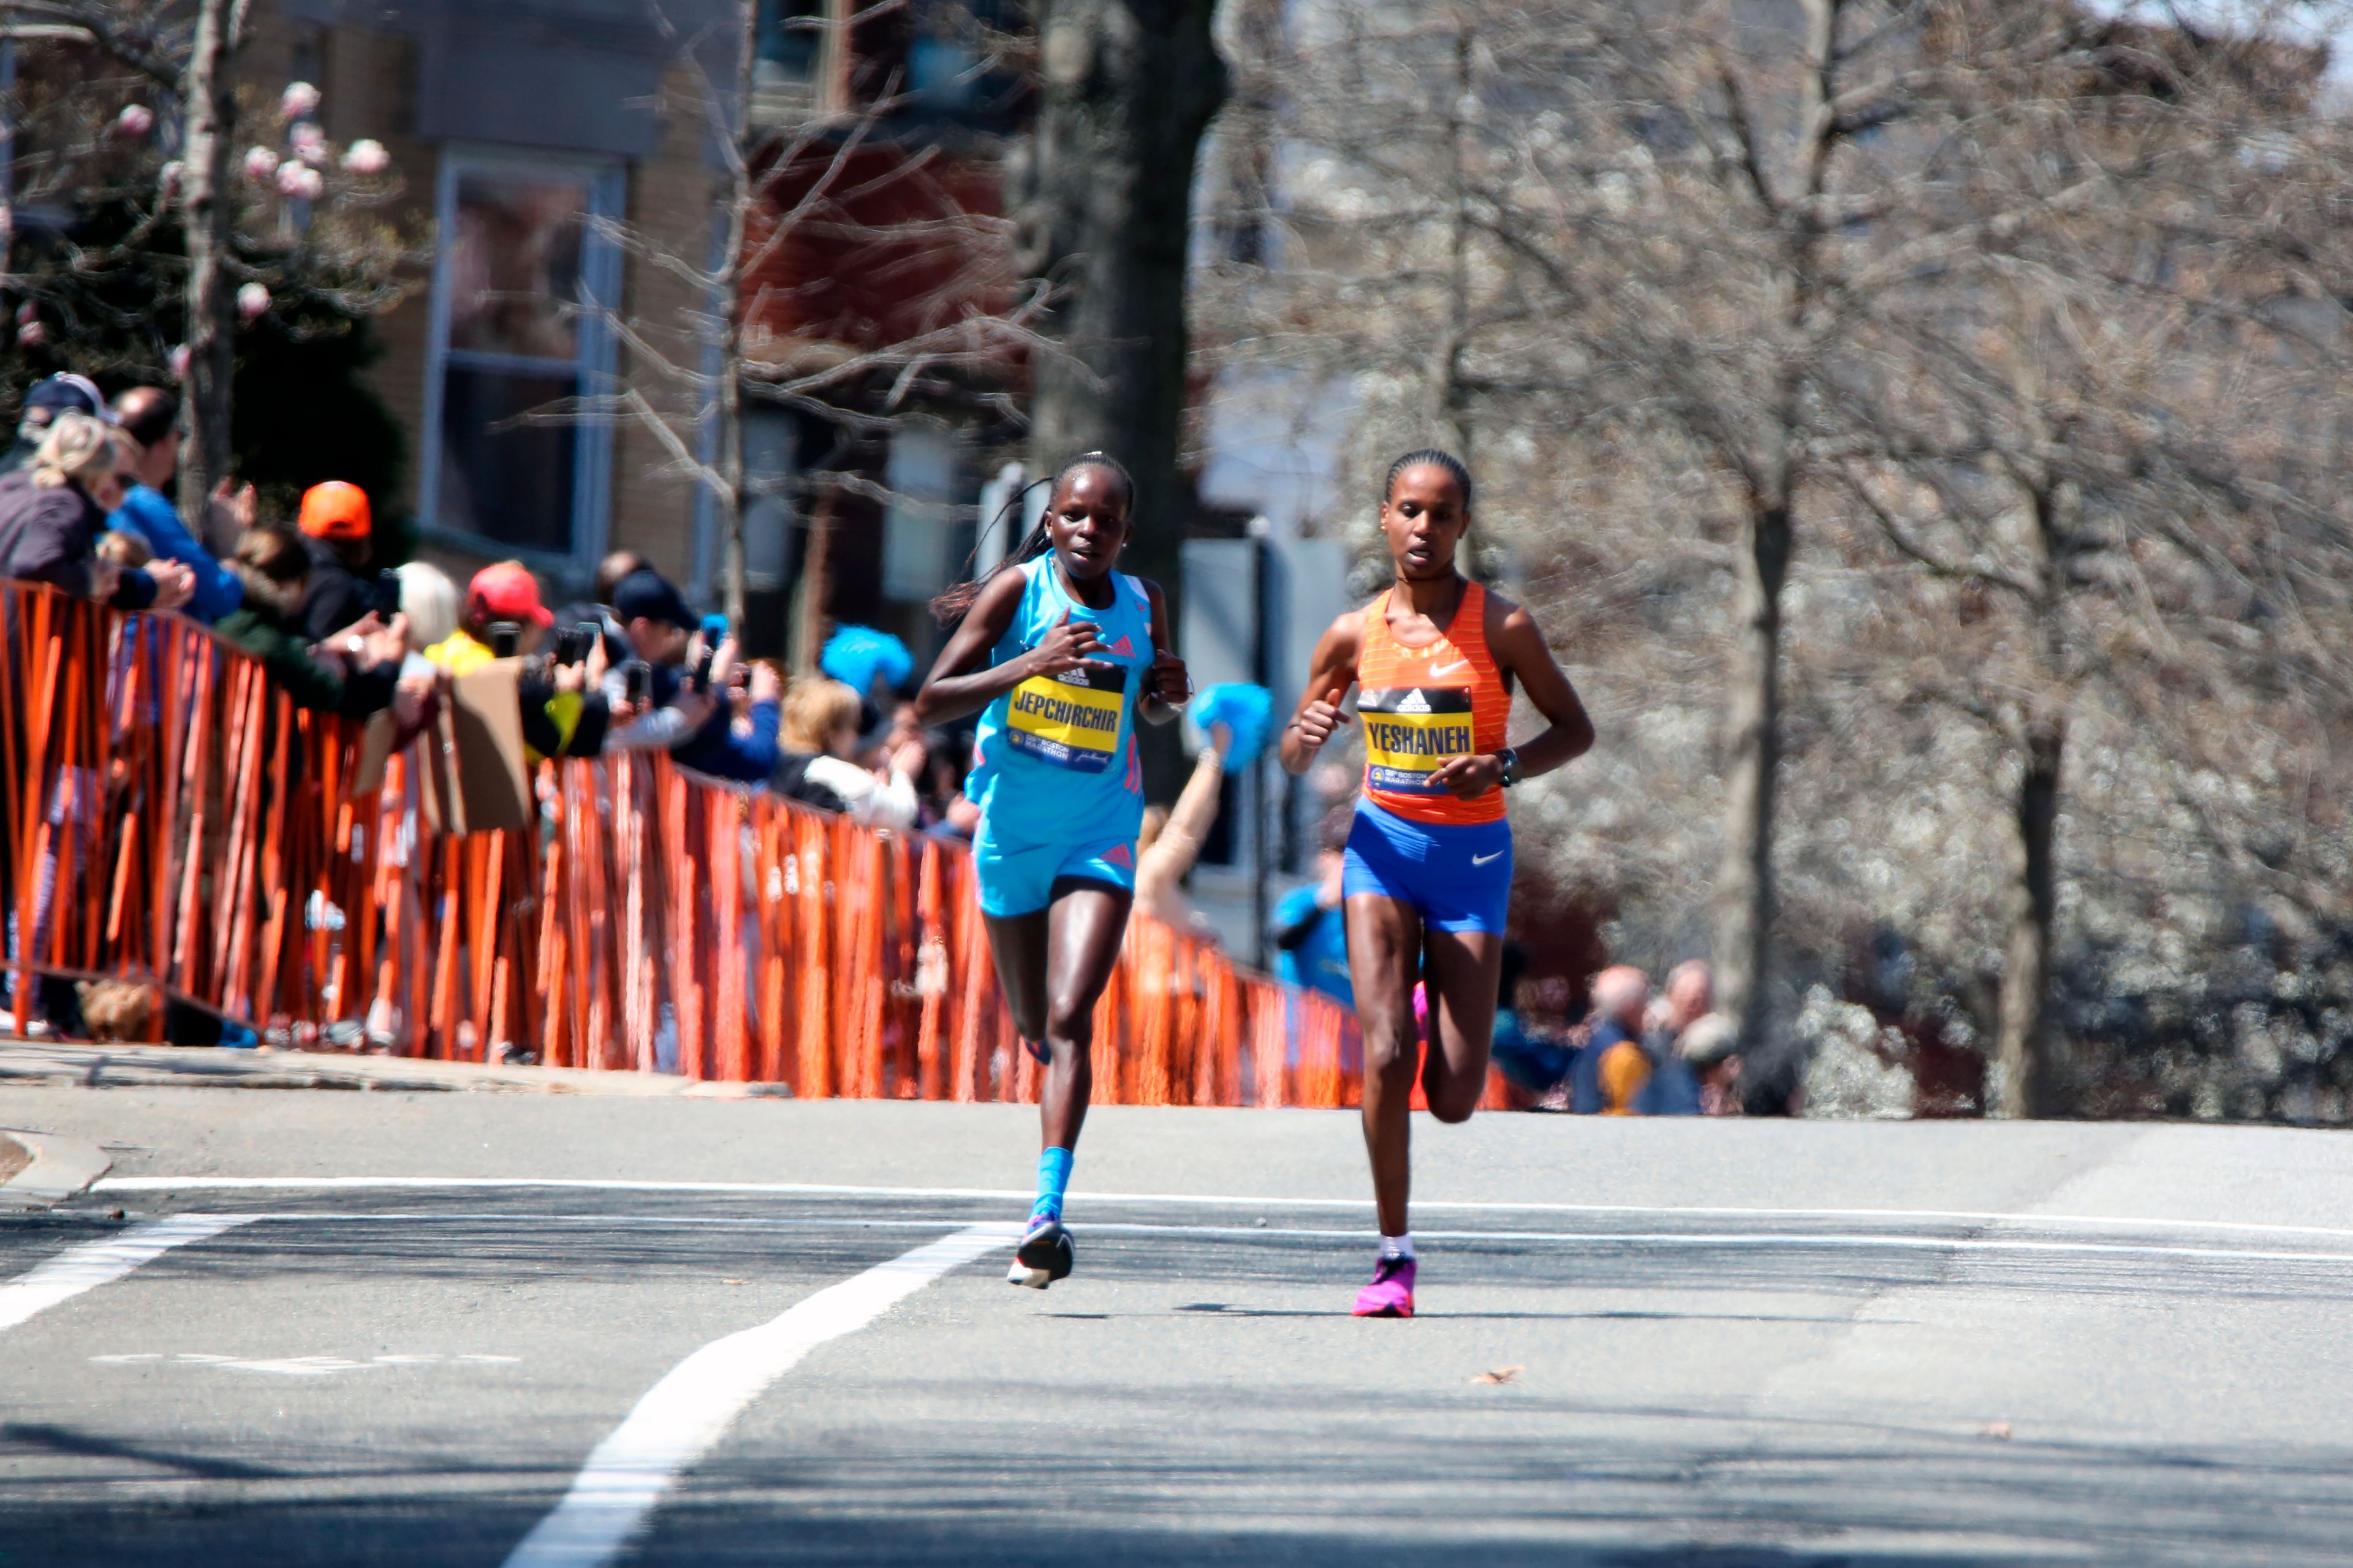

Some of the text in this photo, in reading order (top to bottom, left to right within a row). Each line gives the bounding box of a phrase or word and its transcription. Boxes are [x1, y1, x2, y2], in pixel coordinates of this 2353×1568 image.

[1057, 673, 1089, 686] adidas
[1014, 690, 1118, 733] JEPCHIRCHIR
[1396, 702, 1432, 713] adidas
[1041, 739, 1069, 752] BOSTON
[1368, 722, 1471, 756] YESHANEH
